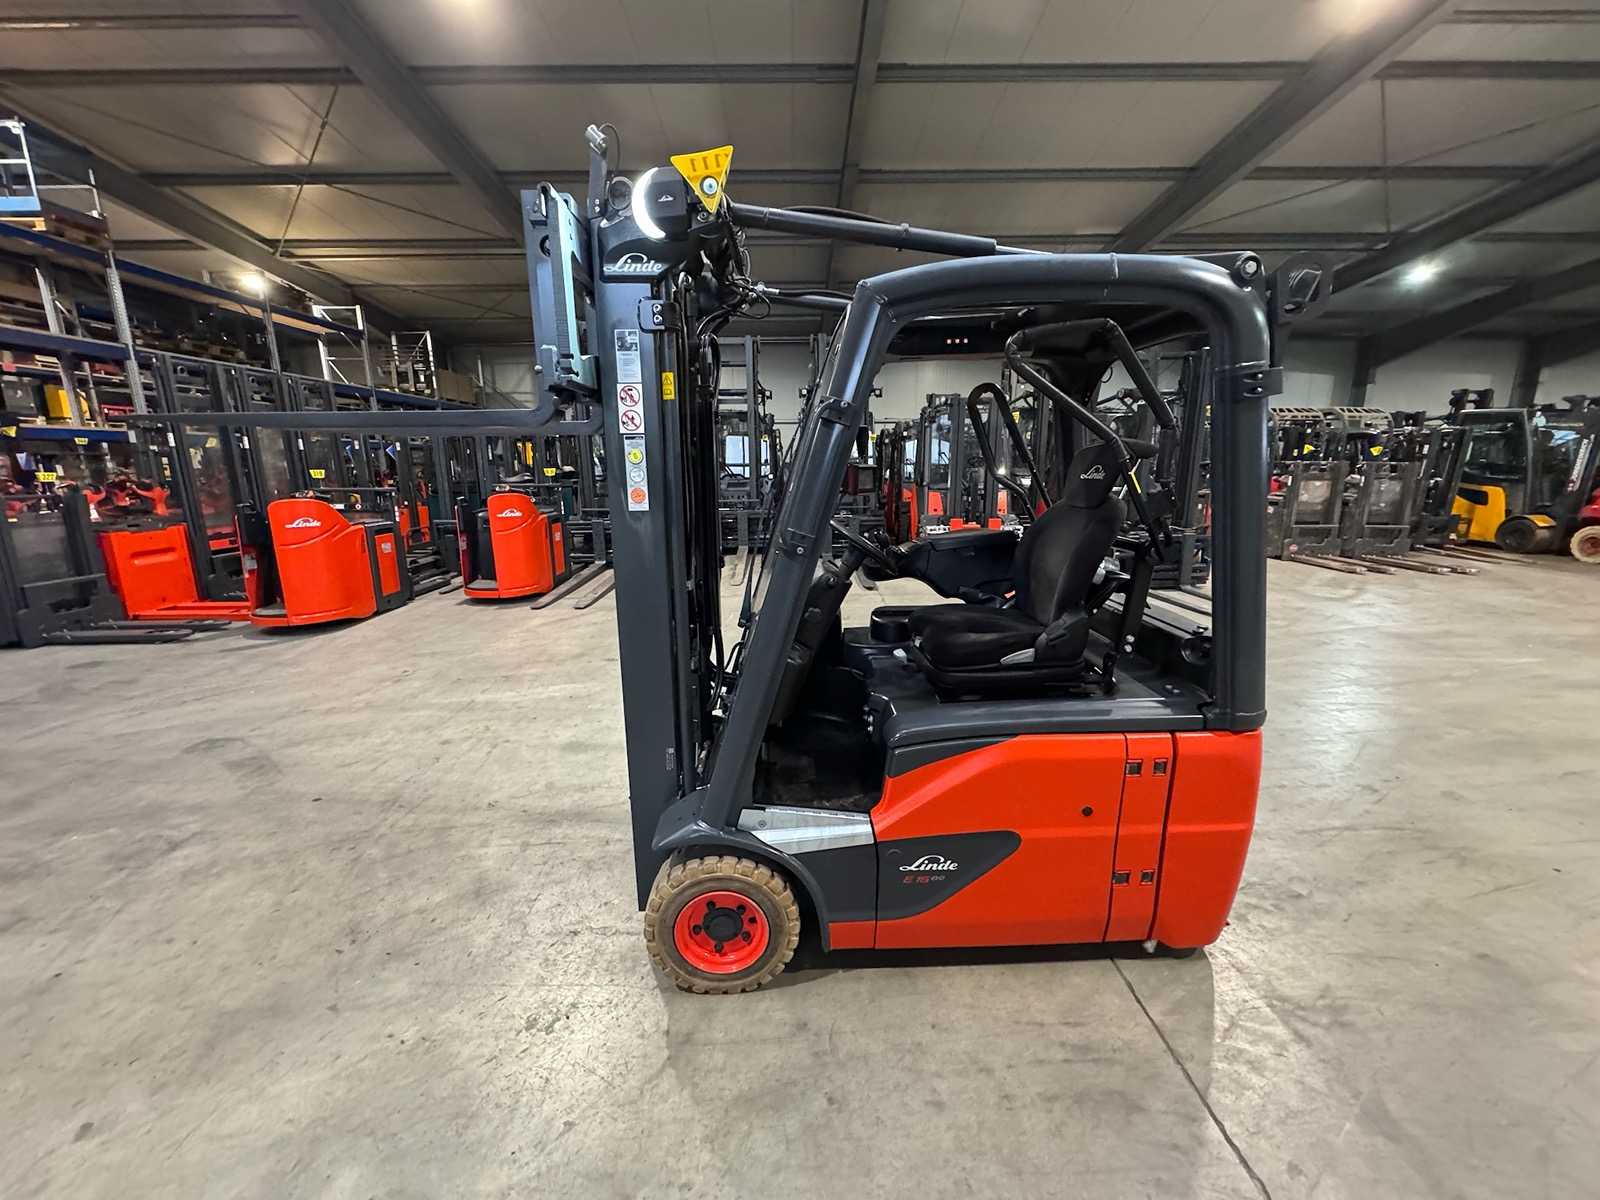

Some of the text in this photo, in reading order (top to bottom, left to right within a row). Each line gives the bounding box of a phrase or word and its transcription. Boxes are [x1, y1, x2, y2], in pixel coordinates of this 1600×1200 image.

[603, 253, 664, 273] Linde
[1080, 465, 1106, 480] Linde
[284, 517, 321, 528] Linde
[899, 855, 959, 871] Linde
